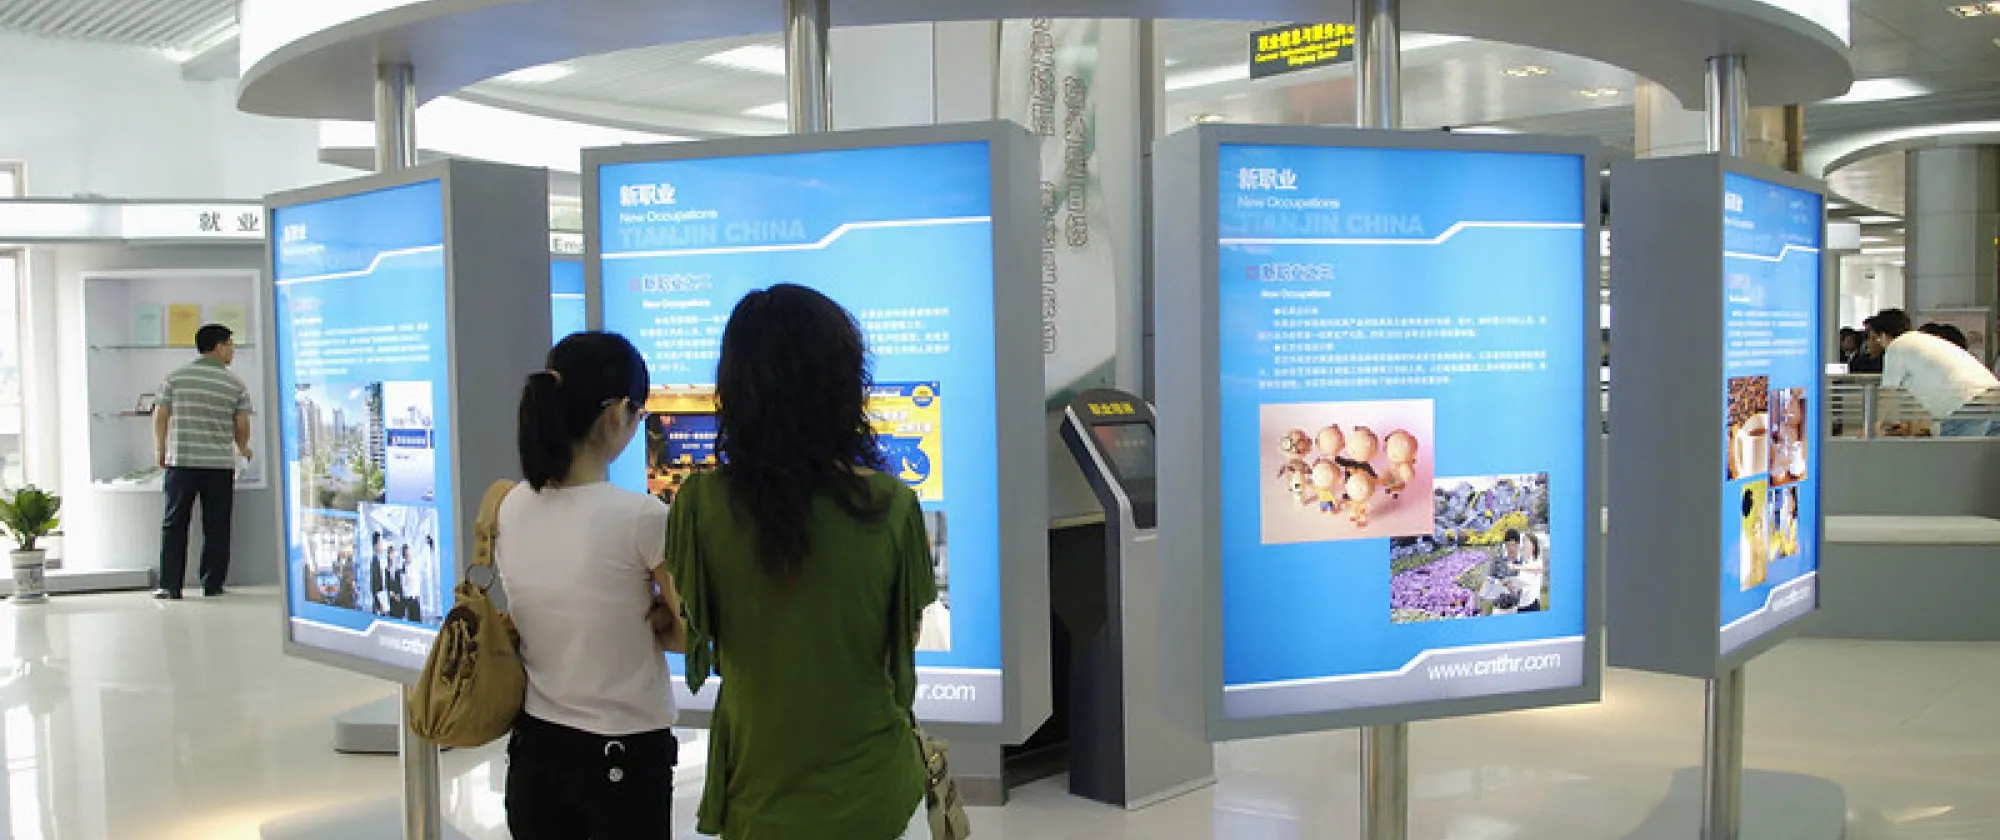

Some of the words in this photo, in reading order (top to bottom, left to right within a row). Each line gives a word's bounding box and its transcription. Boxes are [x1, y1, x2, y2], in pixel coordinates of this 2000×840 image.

[1239, 168, 1298, 191] 新职业
[620, 183, 675, 207] 新职业
[1238, 196, 1265, 208] New
[1267, 196, 1340, 210] Occupations
[620, 212, 644, 223] New
[647, 209, 718, 223] Occupations
[1345, 213, 1424, 235] CHINA
[619, 222, 717, 248] TIANJIN
[724, 218, 807, 244] CHINA
[1427, 653, 1562, 681] www.cnthr.com
